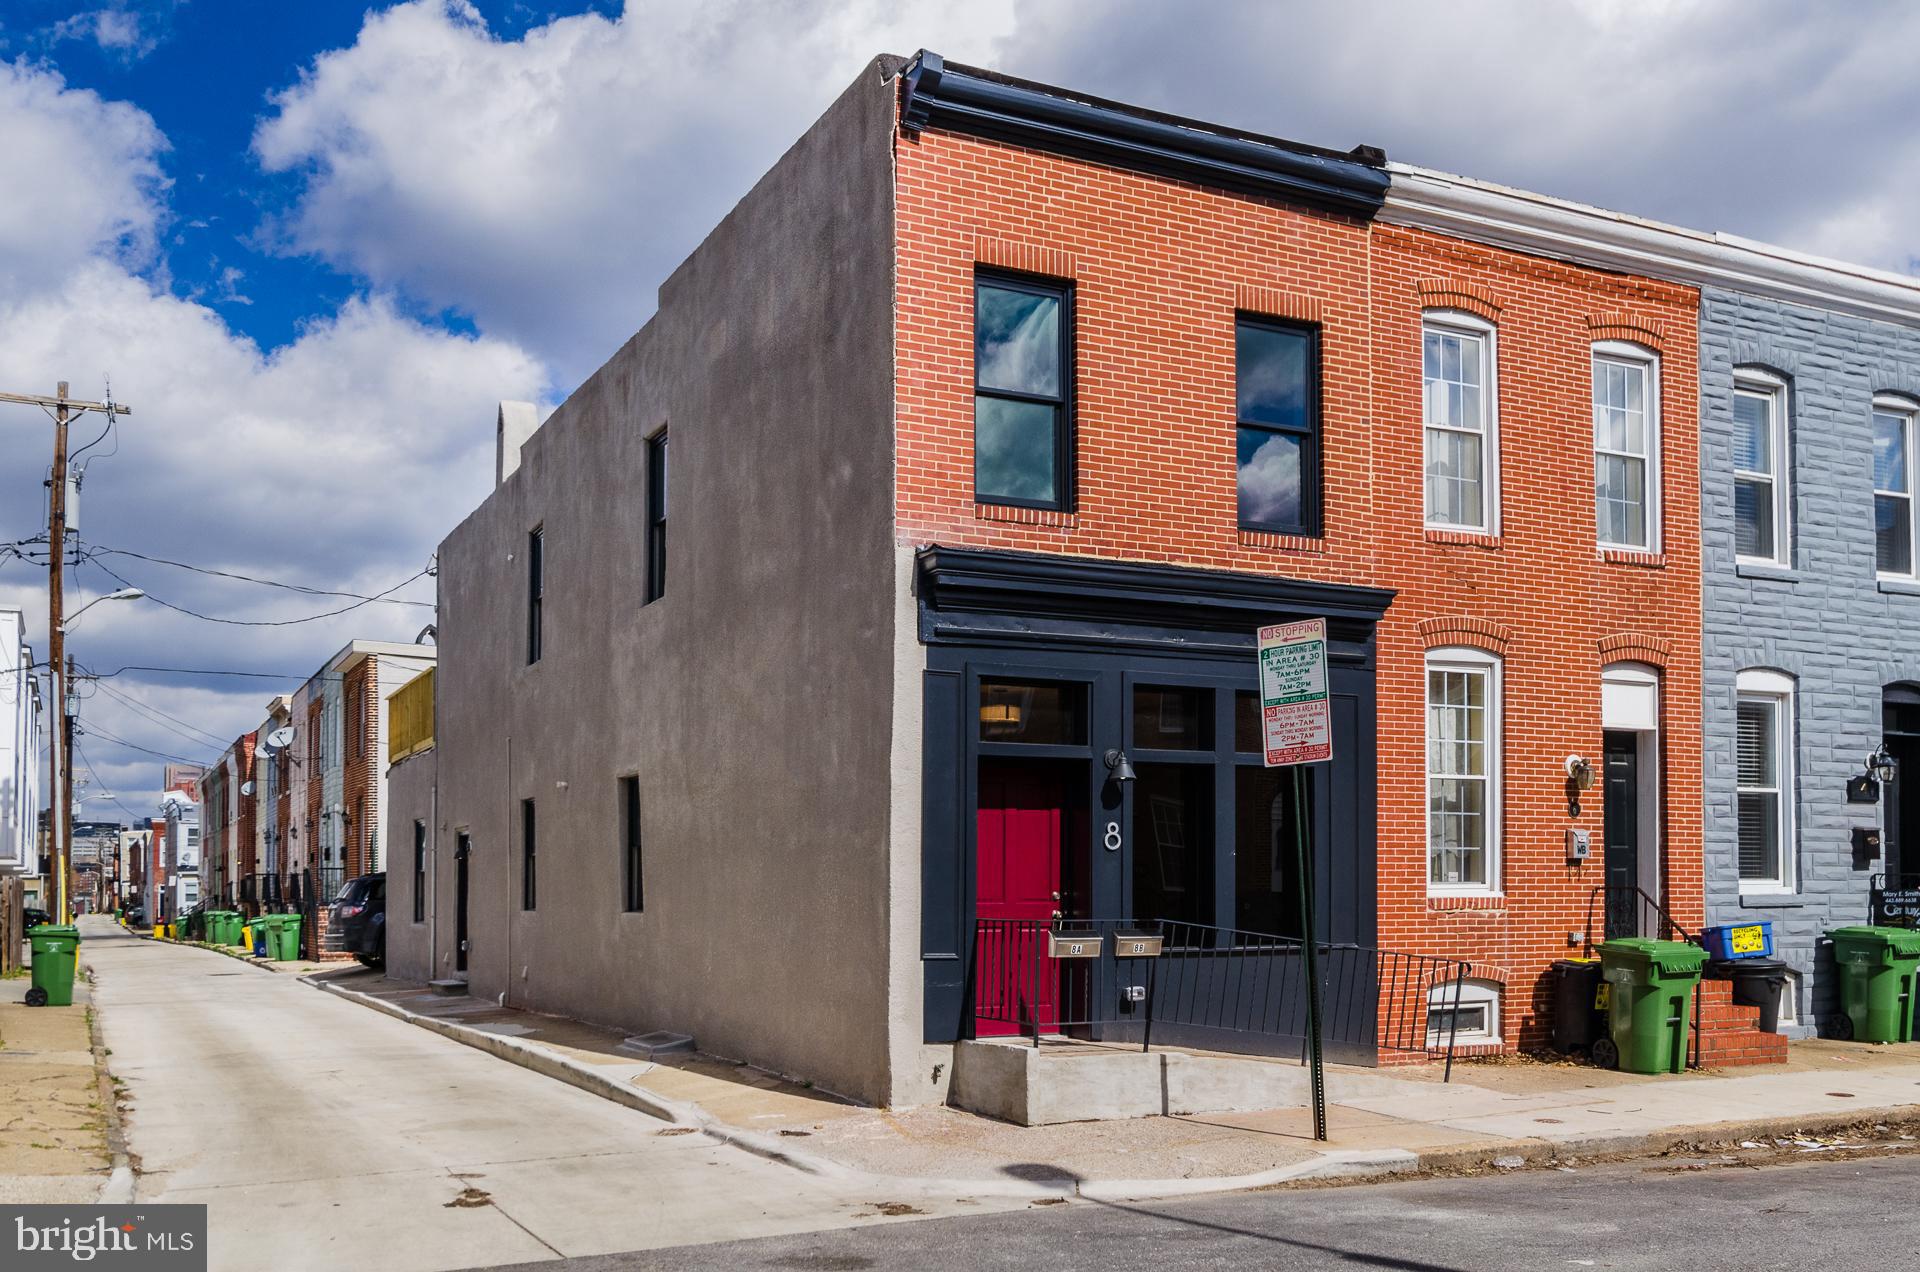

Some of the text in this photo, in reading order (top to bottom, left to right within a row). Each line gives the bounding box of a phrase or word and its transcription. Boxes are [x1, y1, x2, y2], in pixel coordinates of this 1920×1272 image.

[1262, 623, 1319, 639] NO STOPPING
[1263, 643, 1320, 659] 2 HOUR PARKING LIMIT
[1276, 656, 1297, 664] AREA
[1276, 668, 1310, 678] 7AM-6PM
[1279, 681, 1311, 690] 7AM-2PM
[1266, 708, 1276, 717] NO
[1280, 720, 1314, 729] 6PM-7AM
[1281, 733, 1314, 741] 2PM-7AM
[1104, 821, 1122, 851] 8
